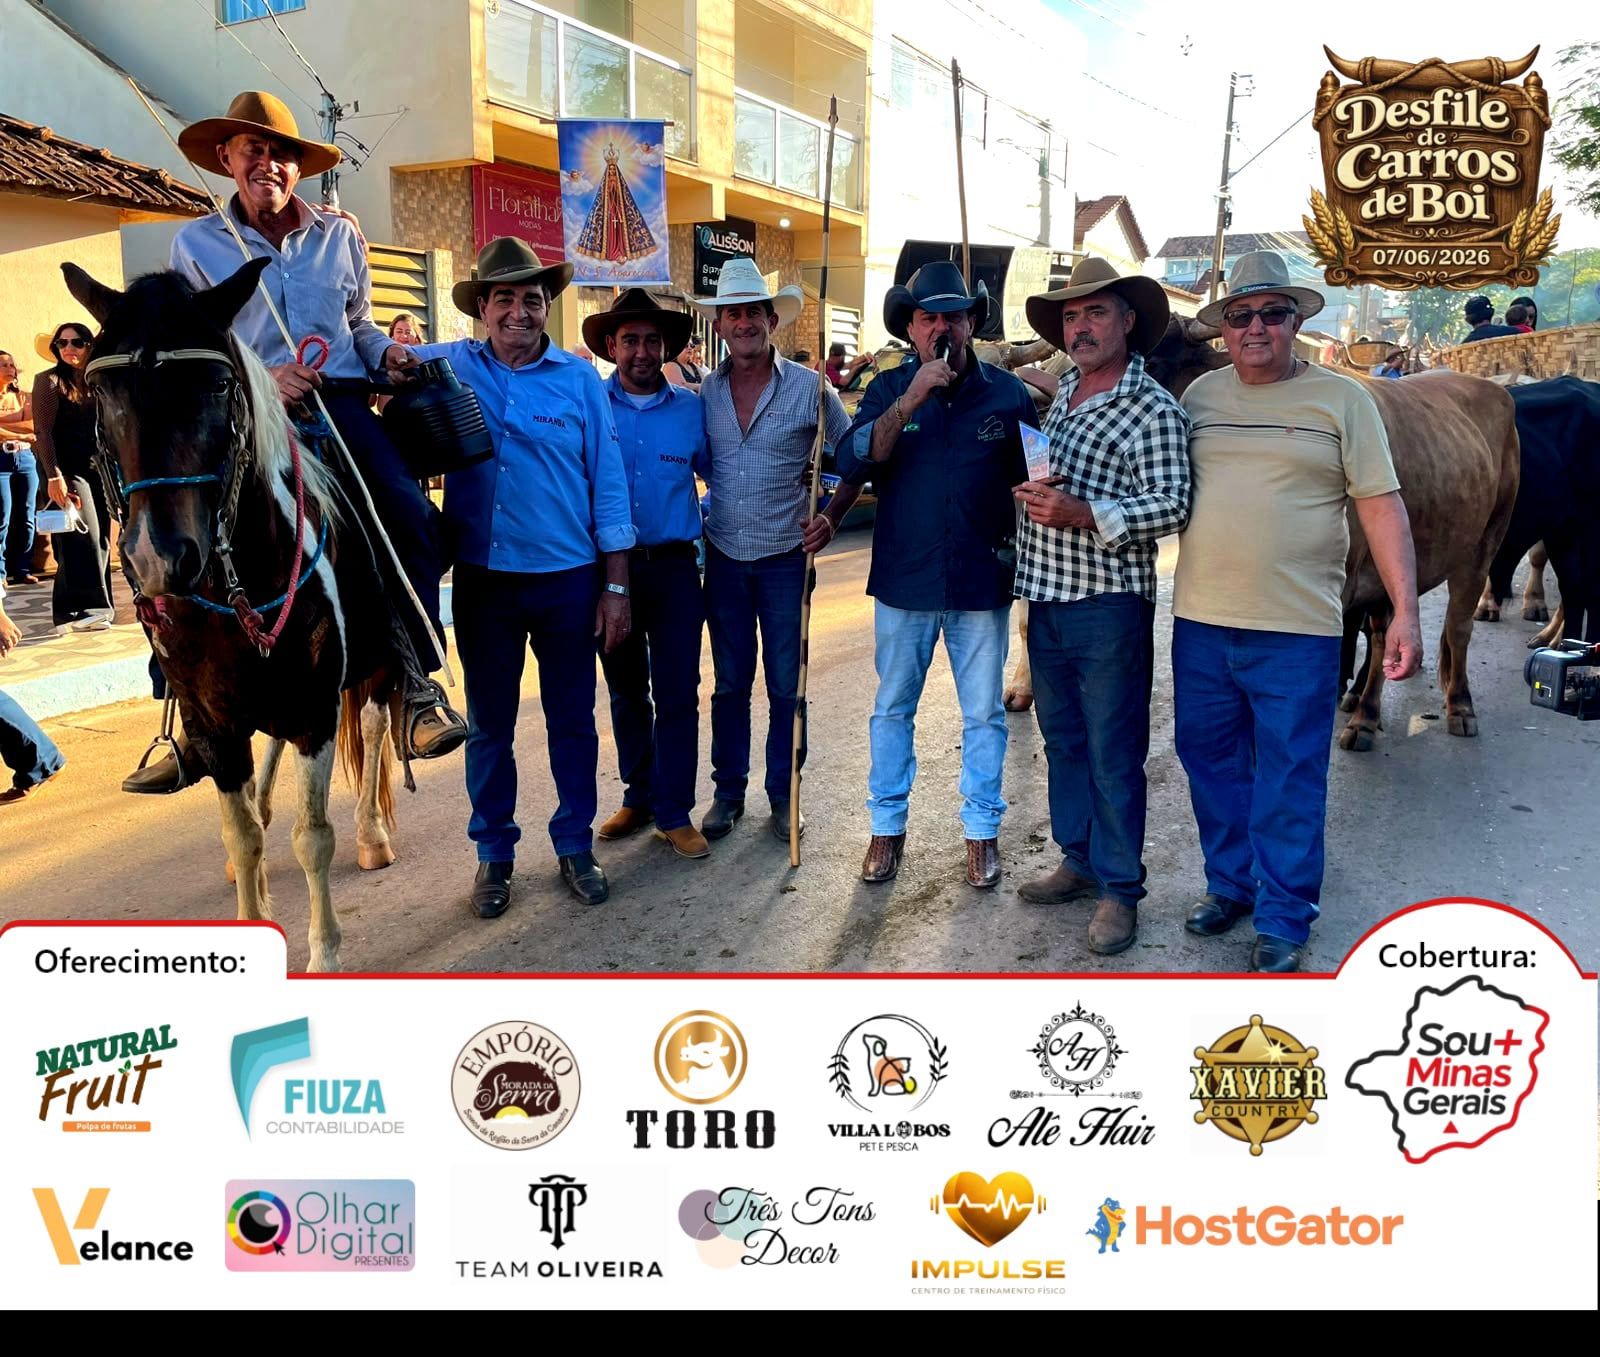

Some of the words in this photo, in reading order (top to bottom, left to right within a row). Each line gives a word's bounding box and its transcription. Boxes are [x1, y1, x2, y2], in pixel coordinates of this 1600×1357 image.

[519, 220, 542, 230] MODAS
[708, 231, 754, 254] ALISSON
[660, 454, 688, 465] RENATO
